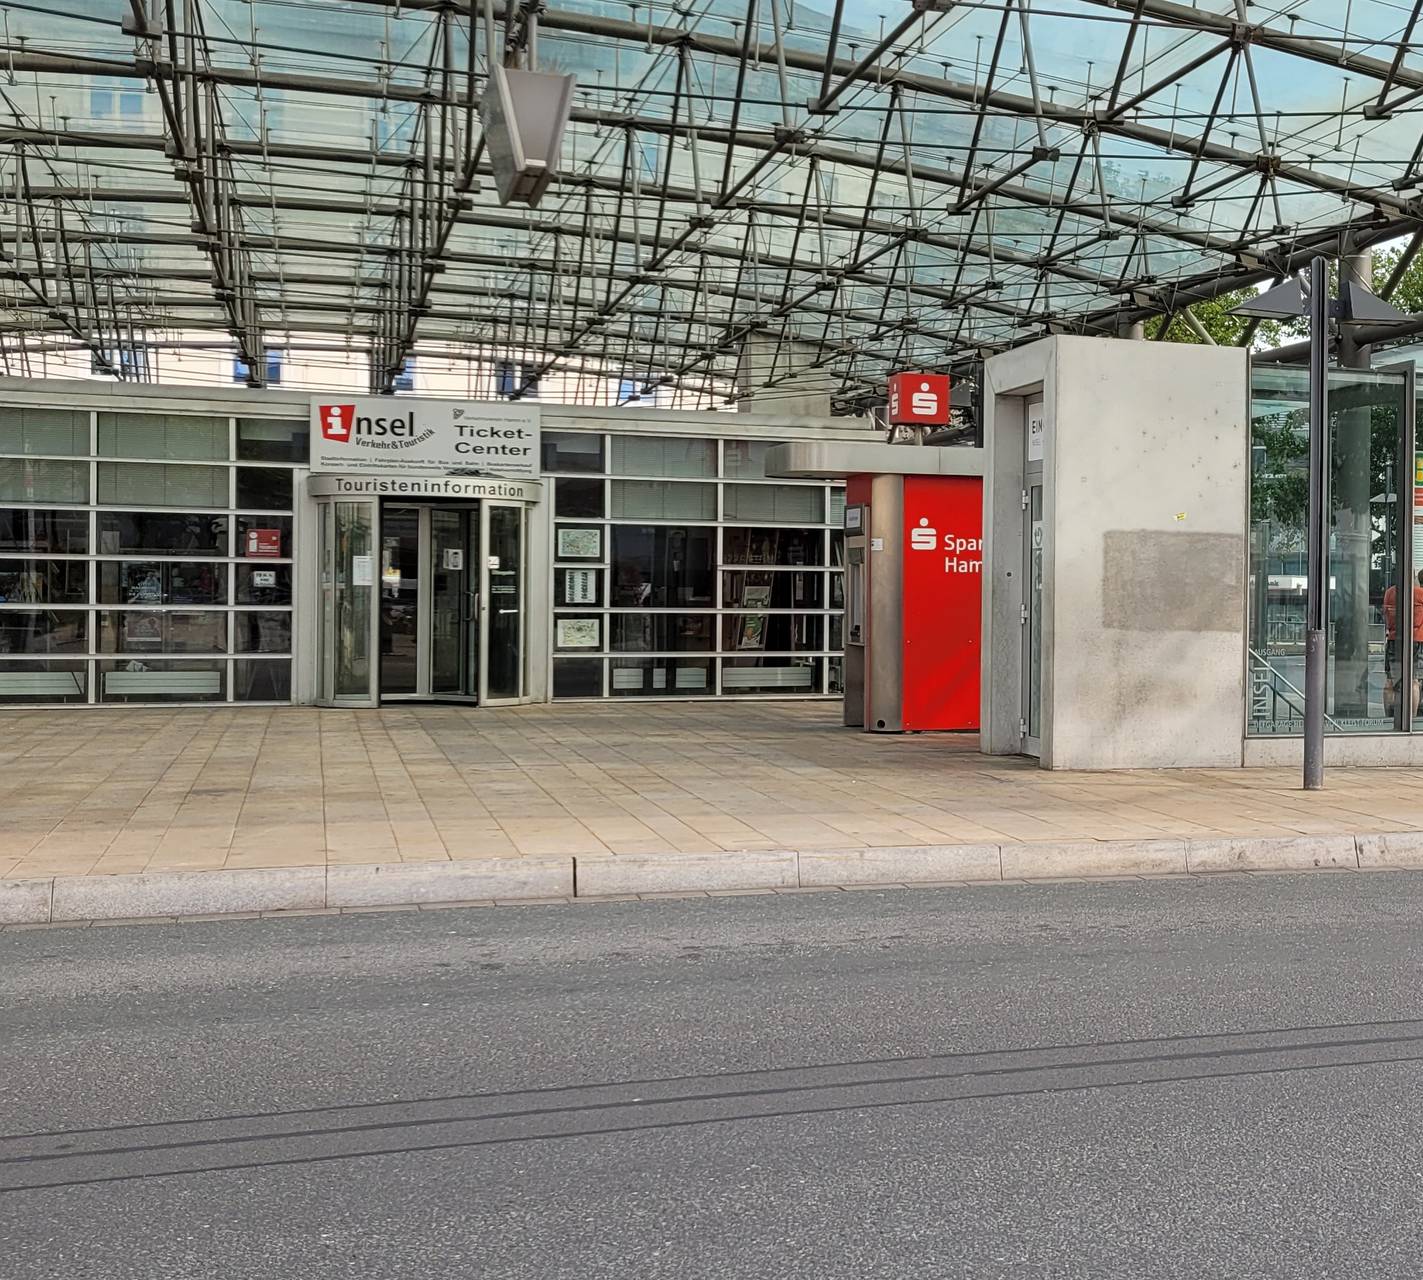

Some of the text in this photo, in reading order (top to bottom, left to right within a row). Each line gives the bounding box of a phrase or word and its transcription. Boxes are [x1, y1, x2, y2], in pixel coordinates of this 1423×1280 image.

[326, 406, 415, 438] insel
[453, 424, 533, 440] Ticket-
[355, 427, 436, 450] Verkehr&Touristik
[454, 442, 532, 456] Center
[335, 478, 524, 498] Touristeninformation
[1253, 660, 1271, 716] INSEL
